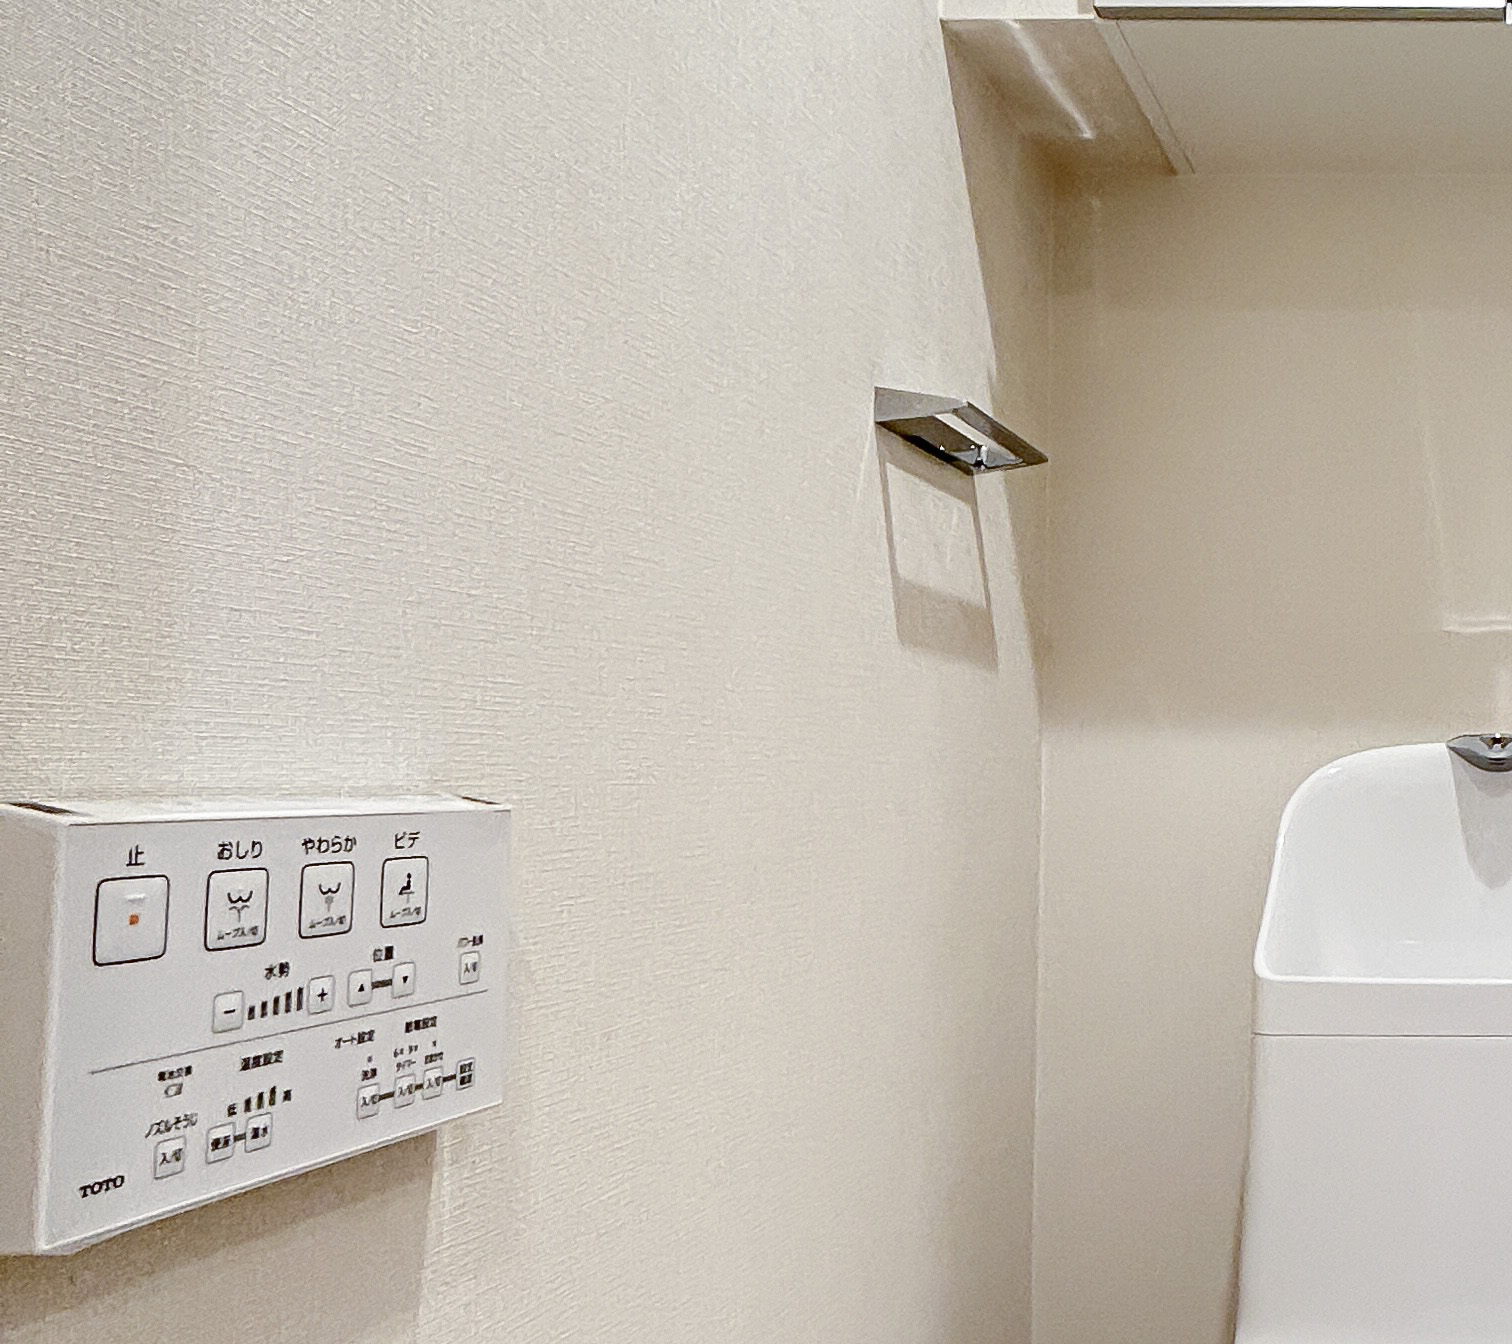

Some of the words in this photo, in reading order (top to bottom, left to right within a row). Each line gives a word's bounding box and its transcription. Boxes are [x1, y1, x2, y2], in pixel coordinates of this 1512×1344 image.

[126, 844, 145, 867] 止
[217, 840, 264, 860] おしり
[301, 836, 358, 855] やわらか
[78, 1175, 125, 1198] TOTO
